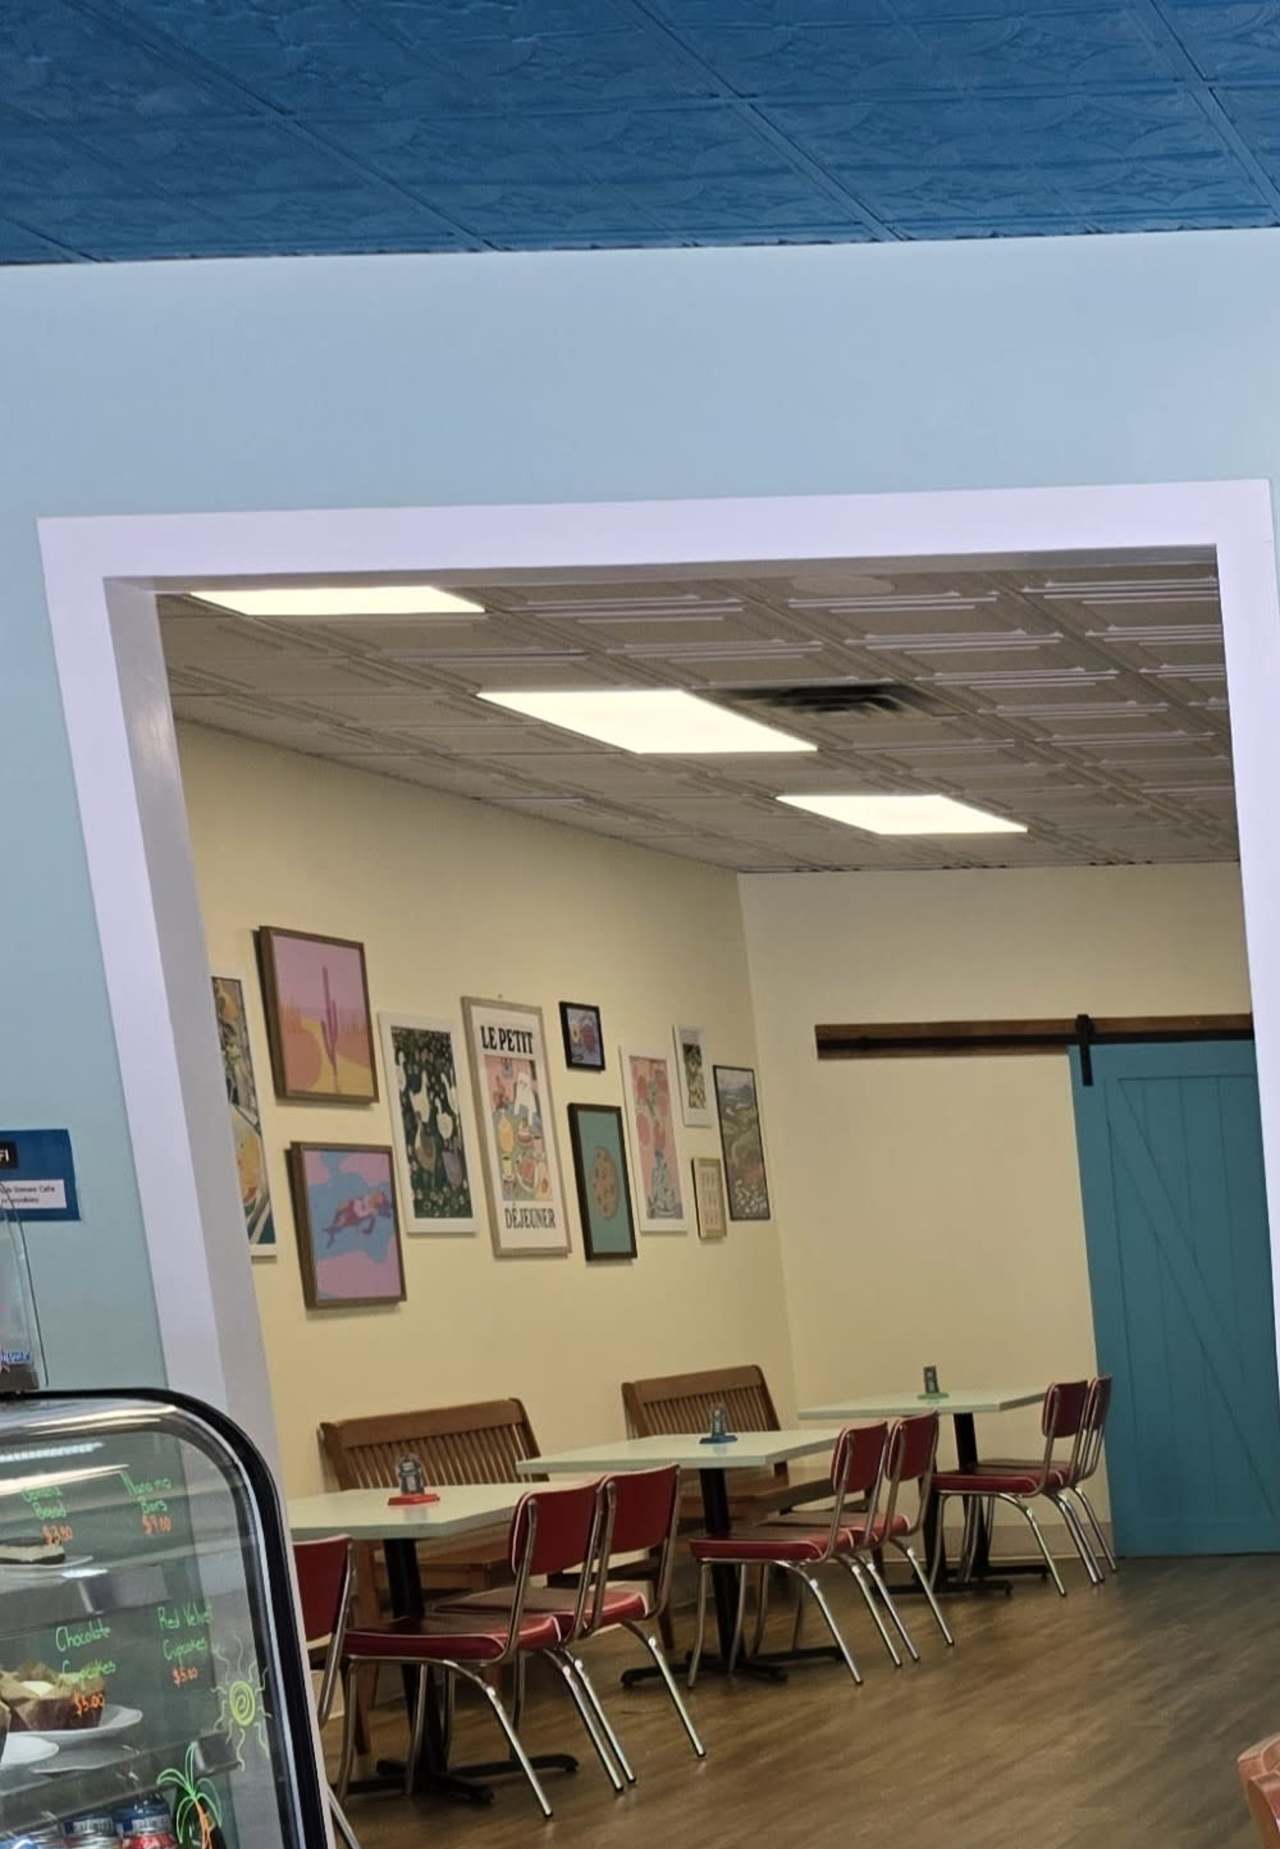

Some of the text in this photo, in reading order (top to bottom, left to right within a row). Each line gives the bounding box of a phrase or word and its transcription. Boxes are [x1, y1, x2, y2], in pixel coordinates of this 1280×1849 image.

[480, 1025, 534, 1054] LE PETIT
[504, 1203, 556, 1230] DÉJEUNER
[55, 1618, 111, 1652] Chocolate
